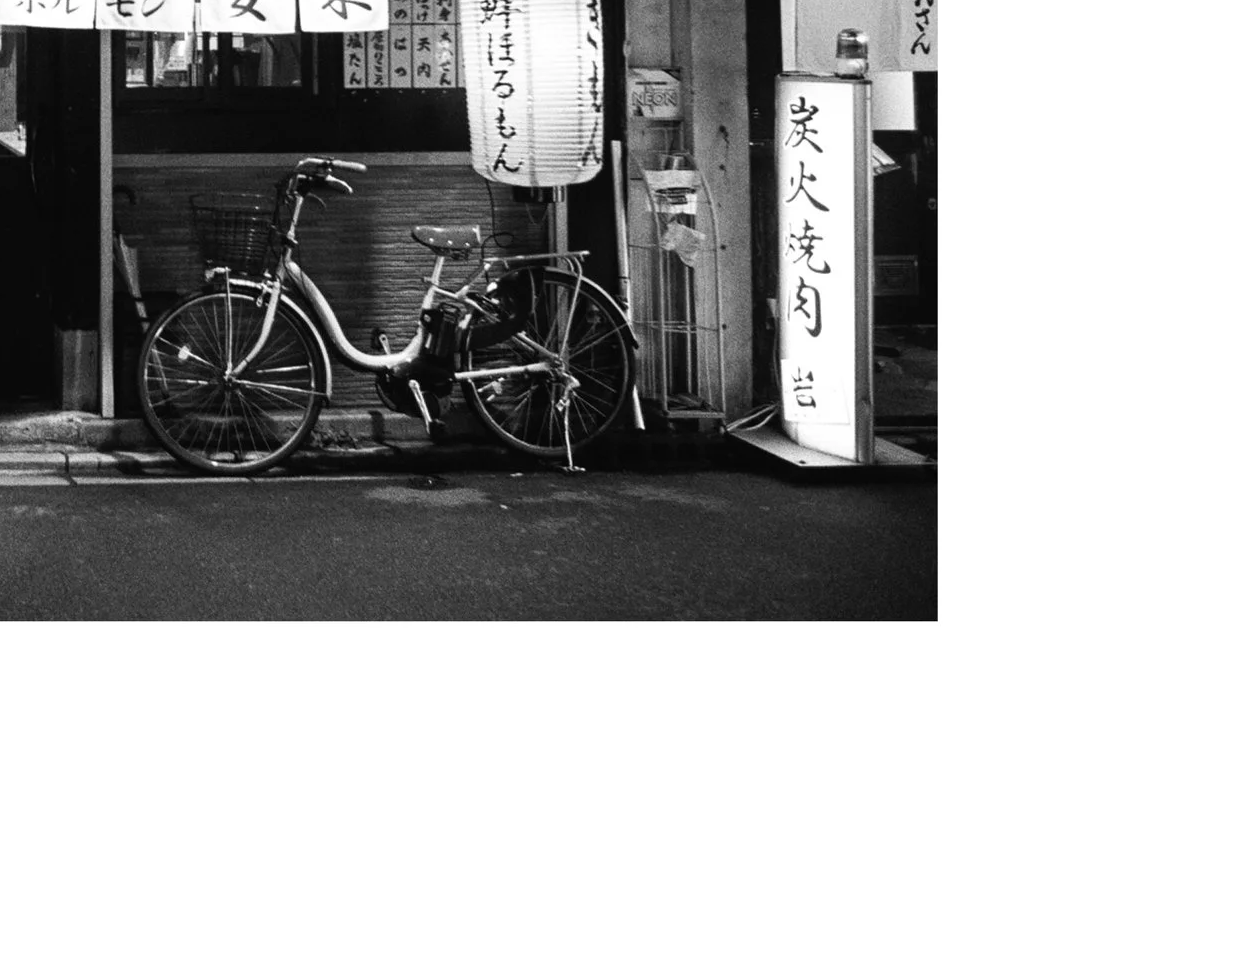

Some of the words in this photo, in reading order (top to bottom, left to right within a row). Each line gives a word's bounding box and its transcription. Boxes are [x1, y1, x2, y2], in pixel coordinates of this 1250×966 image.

[632, 91, 677, 106] NEON
[784, 96, 830, 337] 炭火焼肉
[792, 365, 816, 408] 岩
